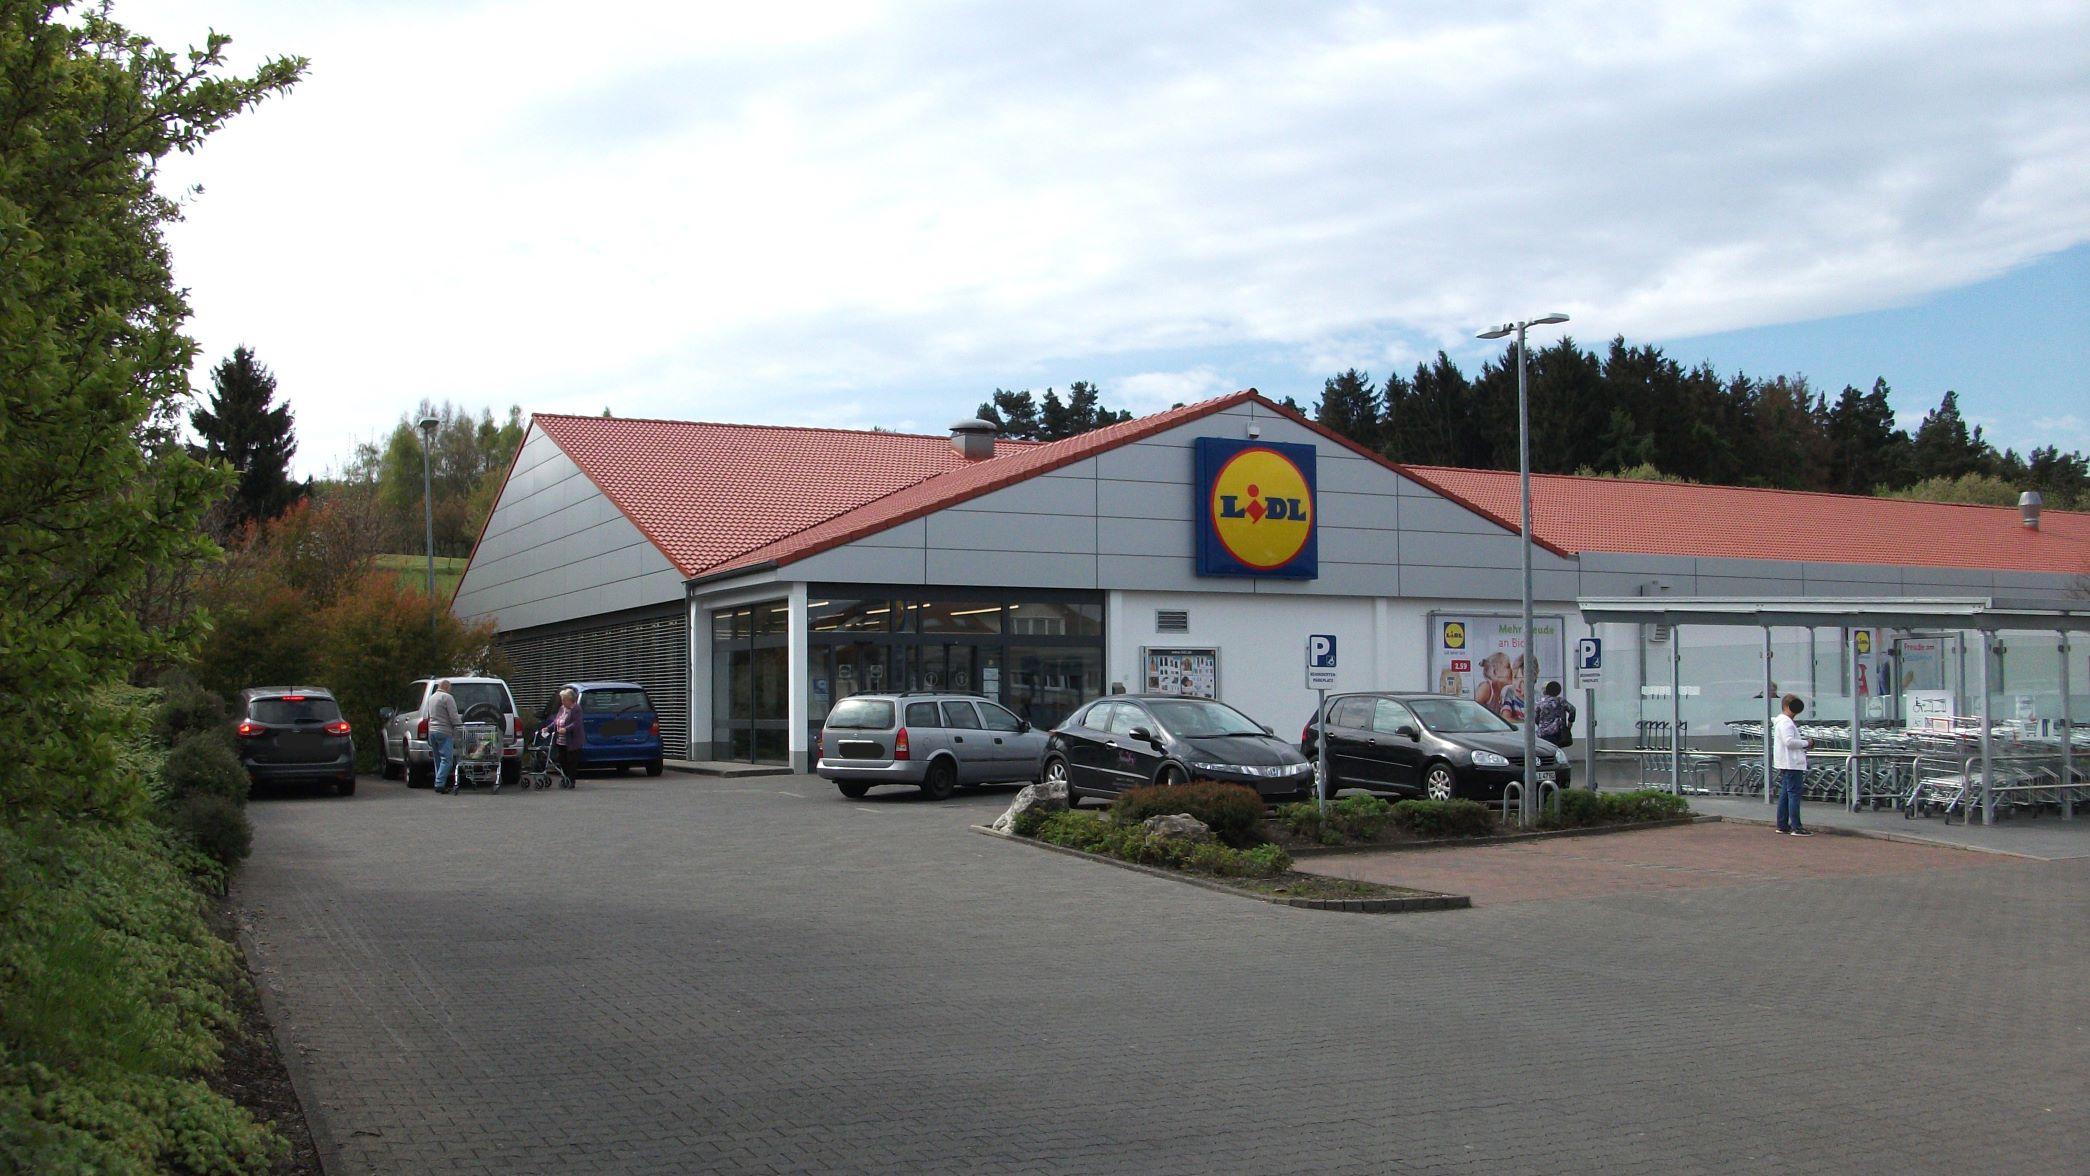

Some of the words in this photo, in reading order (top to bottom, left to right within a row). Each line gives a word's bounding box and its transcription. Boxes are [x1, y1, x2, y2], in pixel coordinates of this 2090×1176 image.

[1498, 624, 1523, 634] Mehr
[1310, 636, 1330, 666] P
[1498, 640, 1509, 648] an
[1580, 640, 1596, 668] P
